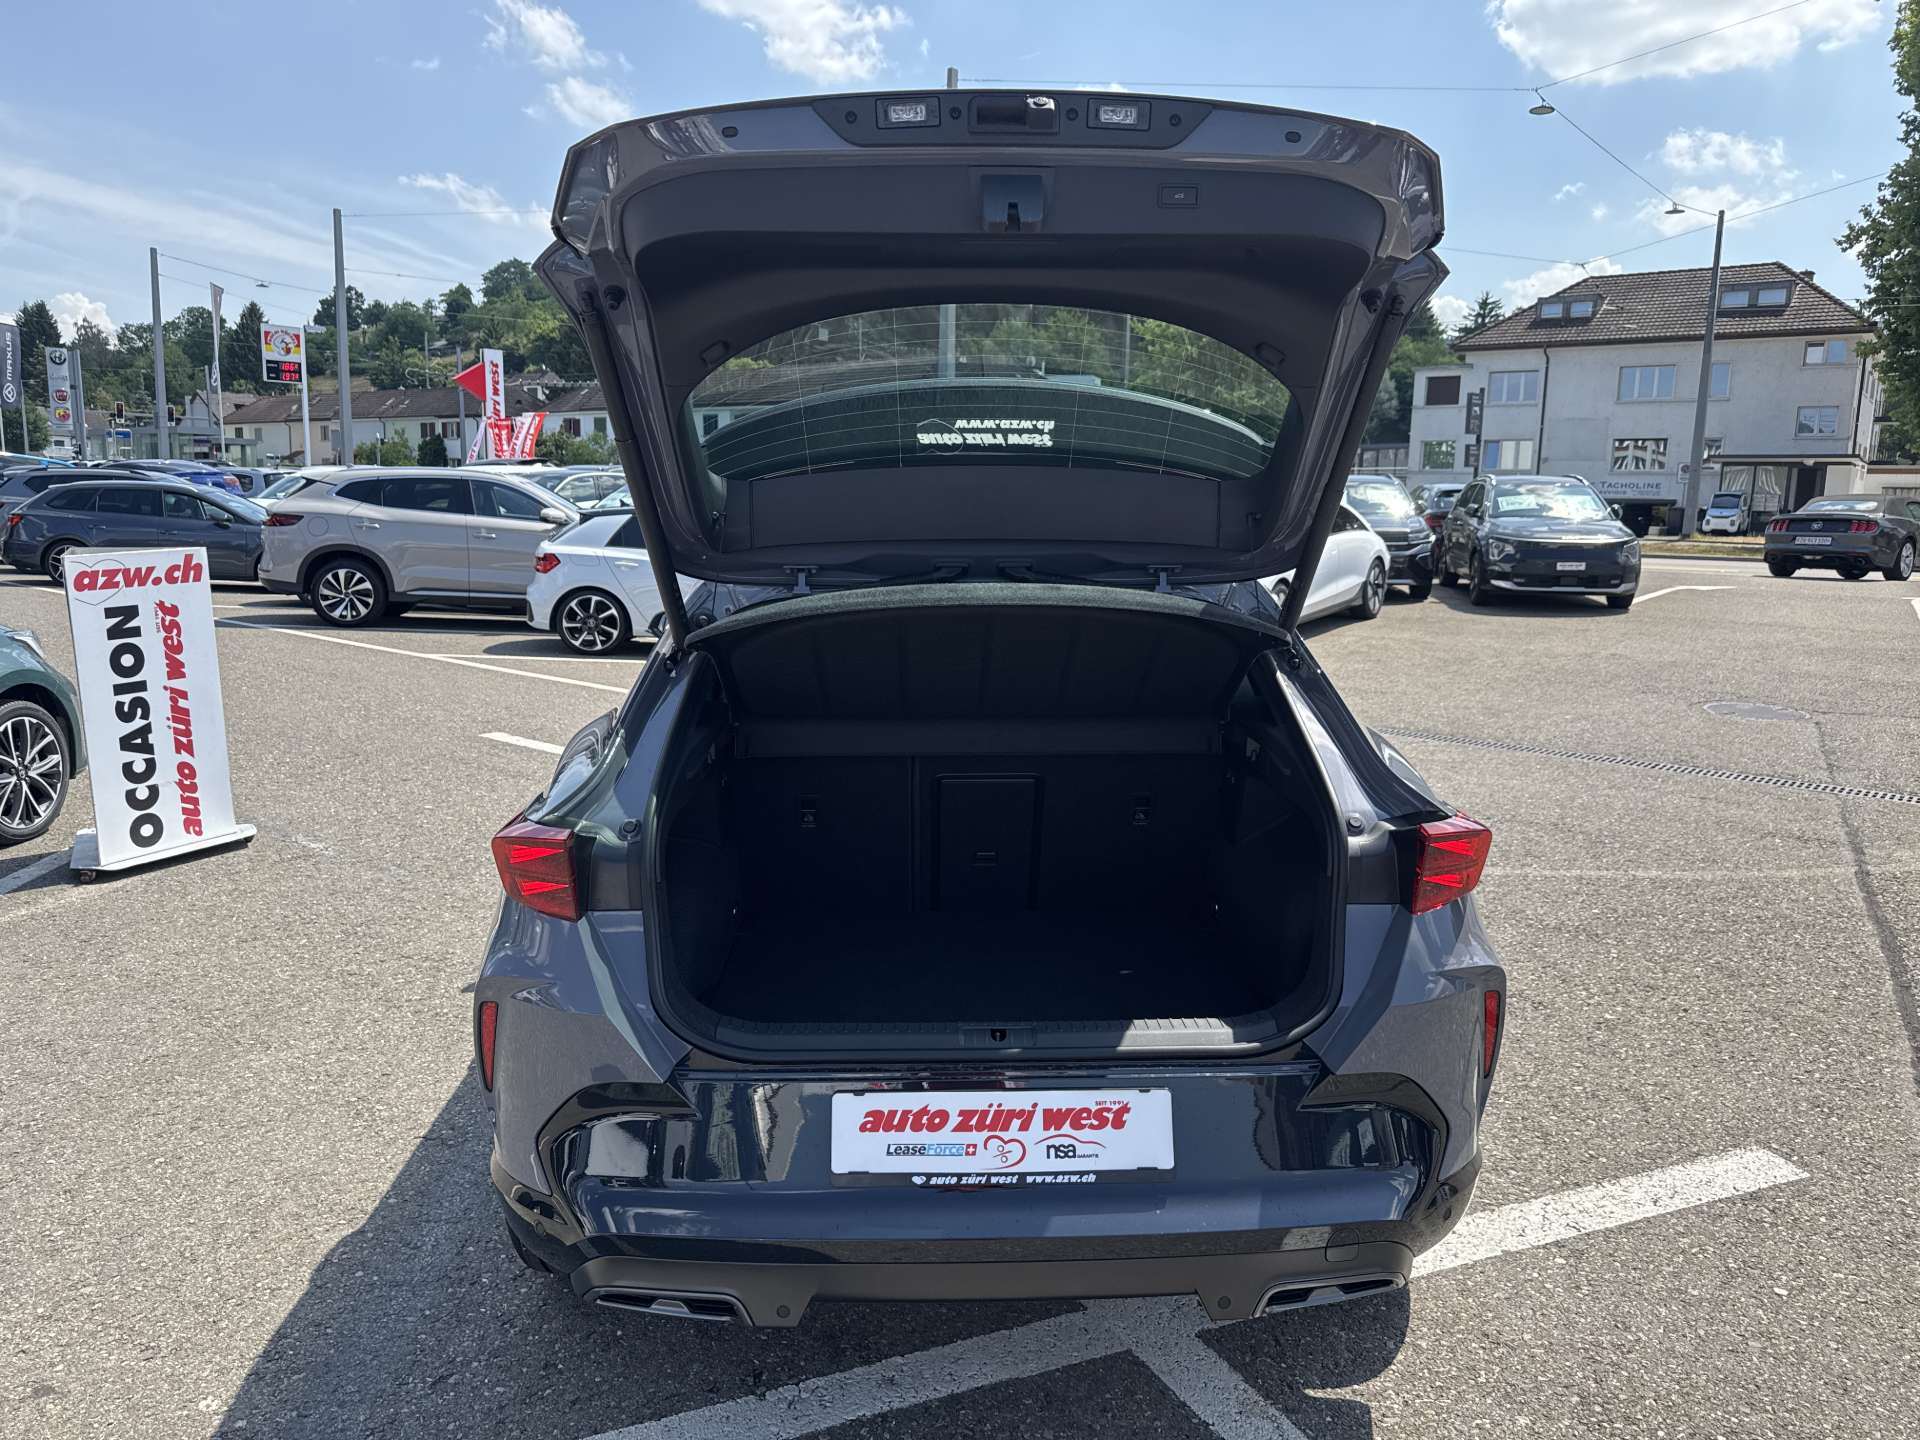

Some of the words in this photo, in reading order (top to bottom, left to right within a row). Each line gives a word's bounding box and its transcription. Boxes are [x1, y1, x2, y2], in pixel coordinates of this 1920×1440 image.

[1600, 481, 1662, 489] TACHOLINE
[73, 553, 203, 593] azw.ch
[154, 600, 186, 681] west
[103, 604, 164, 849] OCCASION
[163, 685, 193, 759] züri
[176, 760, 203, 837] auto
[858, 1104, 949, 1133] auto
[951, 1102, 1038, 1133] züri
[1042, 1100, 1131, 1132] west
[886, 1143, 964, 1157] LeaseForce
[1046, 1144, 1077, 1160] nsa
[929, 1175, 957, 1185] auto
[959, 1174, 985, 1185] züri
[990, 1175, 1018, 1185] west
[1026, 1174, 1096, 1184] www.azw.ch
